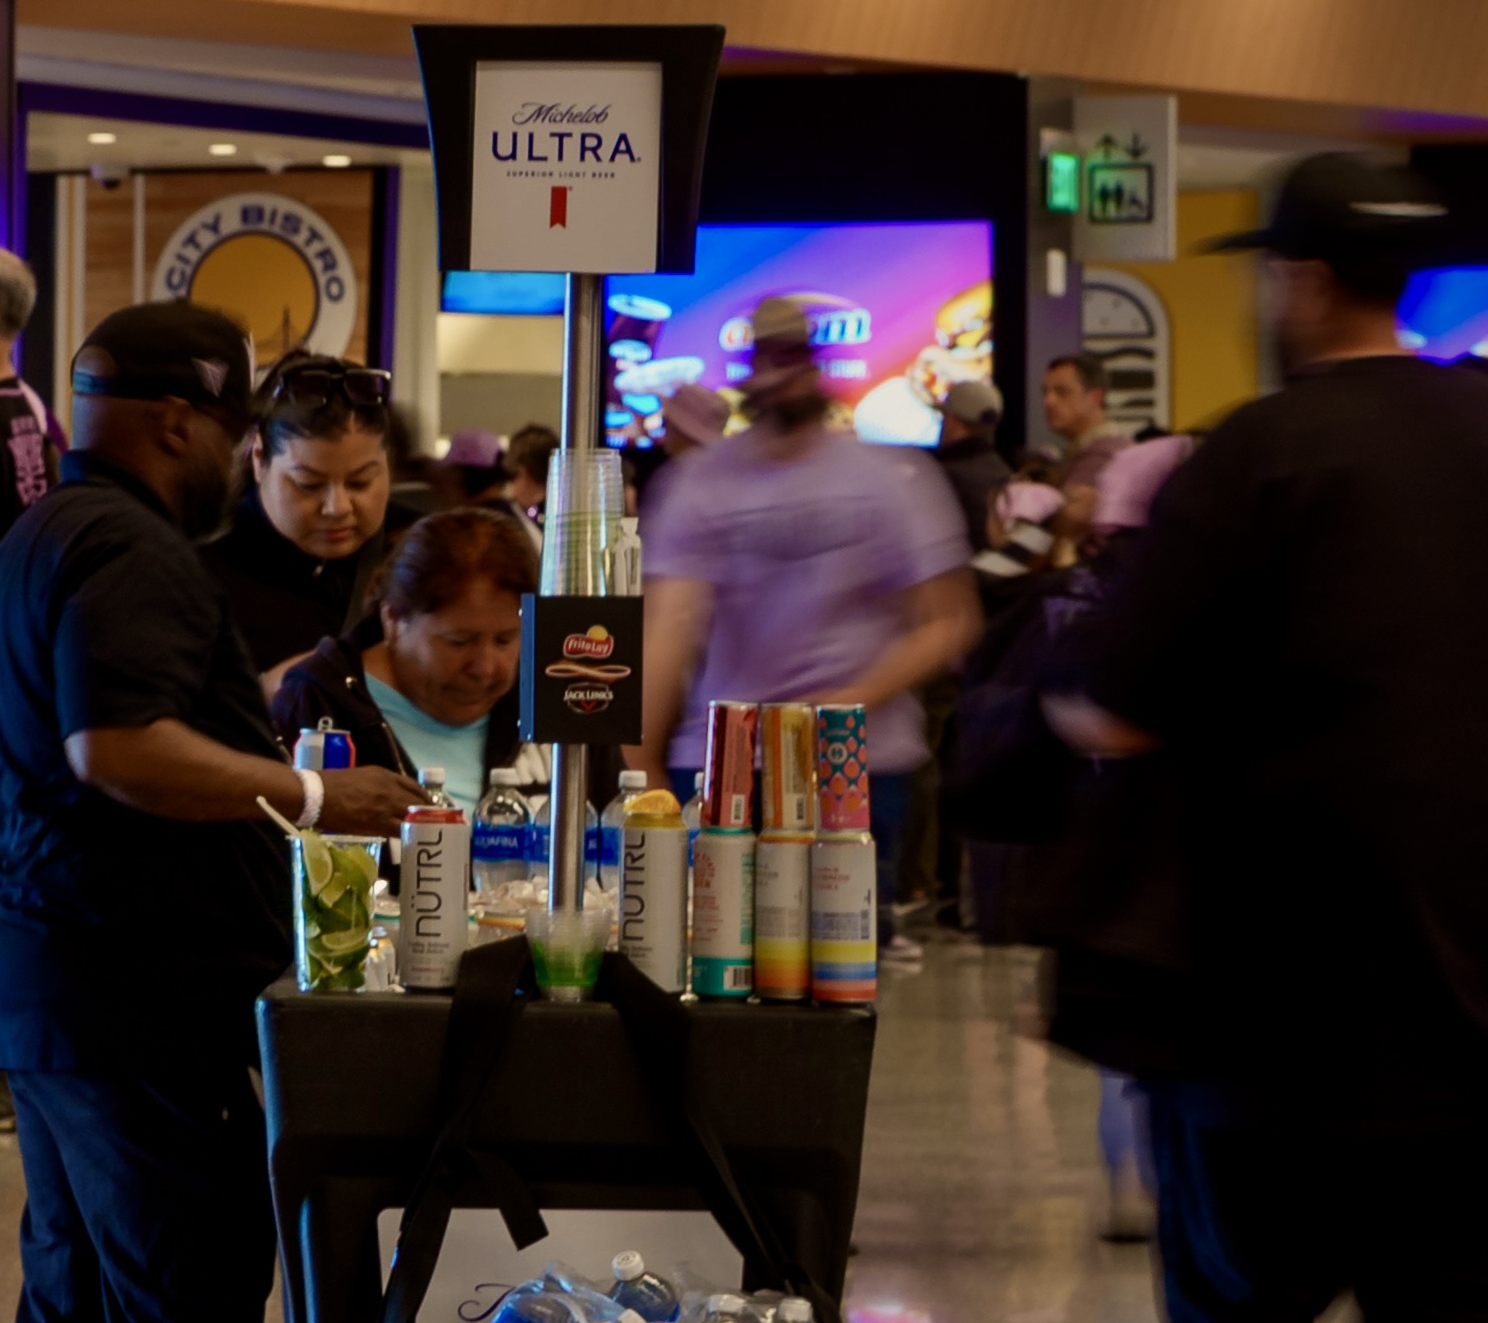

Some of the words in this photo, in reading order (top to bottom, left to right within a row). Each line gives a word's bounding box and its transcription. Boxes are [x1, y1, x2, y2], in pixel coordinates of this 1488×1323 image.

[512, 102, 612, 125] Michelob
[491, 131, 636, 163] ULTRA
[165, 212, 222, 292] CITY
[240, 205, 346, 303] BISTRO
